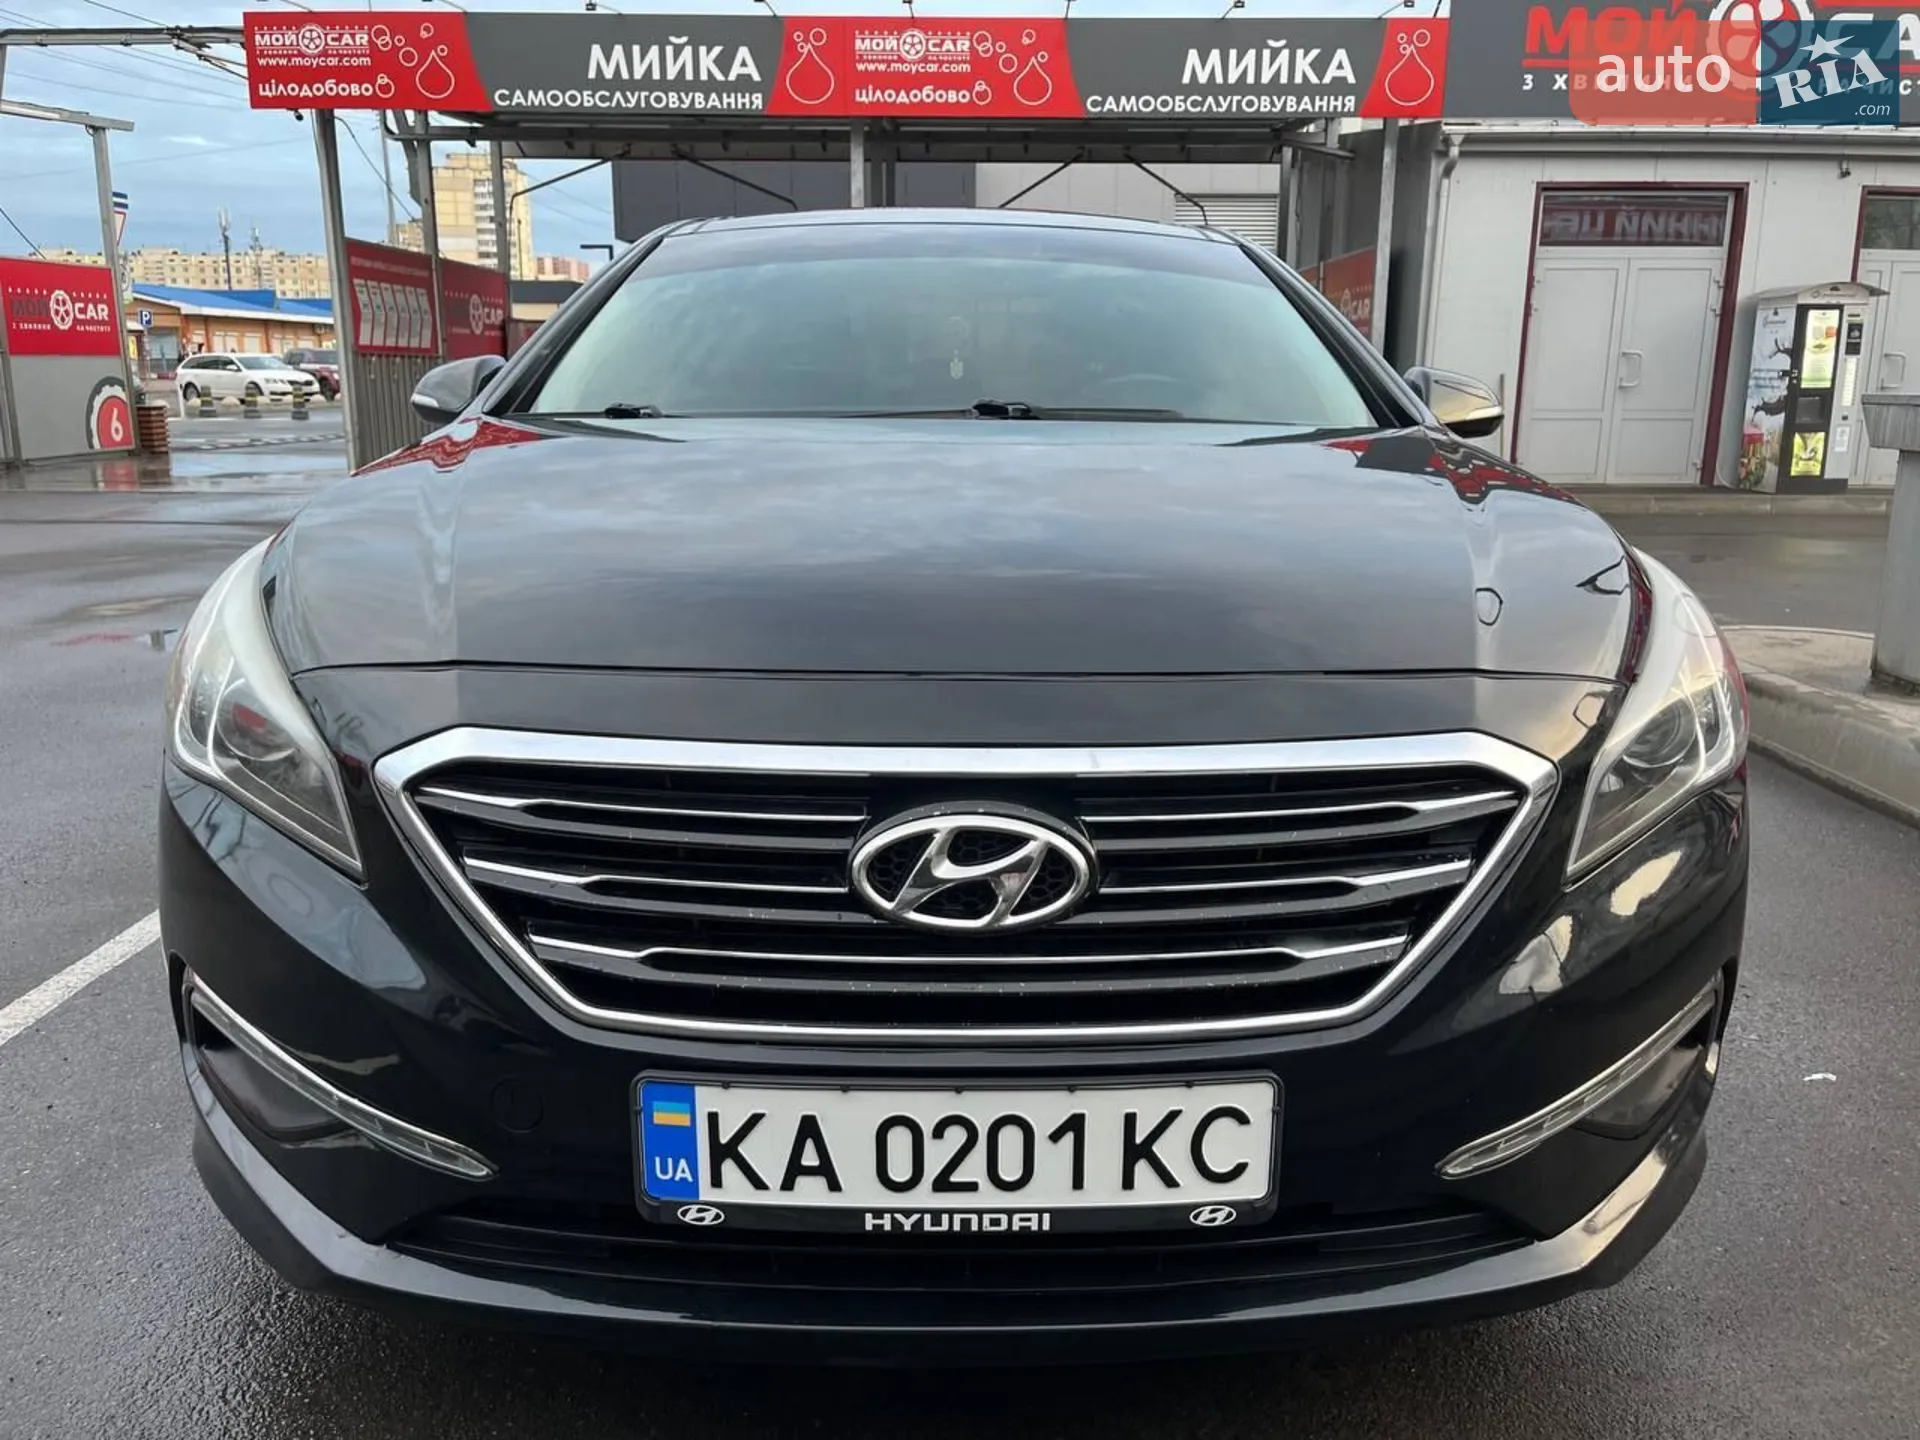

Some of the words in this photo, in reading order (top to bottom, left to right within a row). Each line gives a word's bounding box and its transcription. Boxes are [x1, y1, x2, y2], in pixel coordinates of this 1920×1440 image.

[255, 32, 297, 46] МОЙ
[327, 34, 369, 46] CAR
[855, 37, 898, 50] МОЙ
[928, 39, 970, 51] CAR
[258, 57, 371, 68] www.moycar.com
[588, 36, 761, 81] МИЙКА
[1181, 39, 1356, 84] МИЙКА
[856, 63, 971, 74] www.moycar.com
[258, 79, 373, 98] цілодобово
[855, 85, 970, 104] цілодобово
[494, 89, 763, 110] САМООБСЛУГОВУВАННЯ
[1086, 94, 1356, 112] САМООБСЛУГОВУВАННЯ
[75, 303, 109, 321] CAR
[142, 311, 150, 324] P
[111, 408, 123, 442] 6
[707, 1111, 843, 1192] KA
[875, 1112, 1085, 1192] 0201
[1122, 1106, 1252, 1190] KC
[655, 1158, 692, 1183] UA
[865, 1212, 1051, 1232] HYUNDAI
